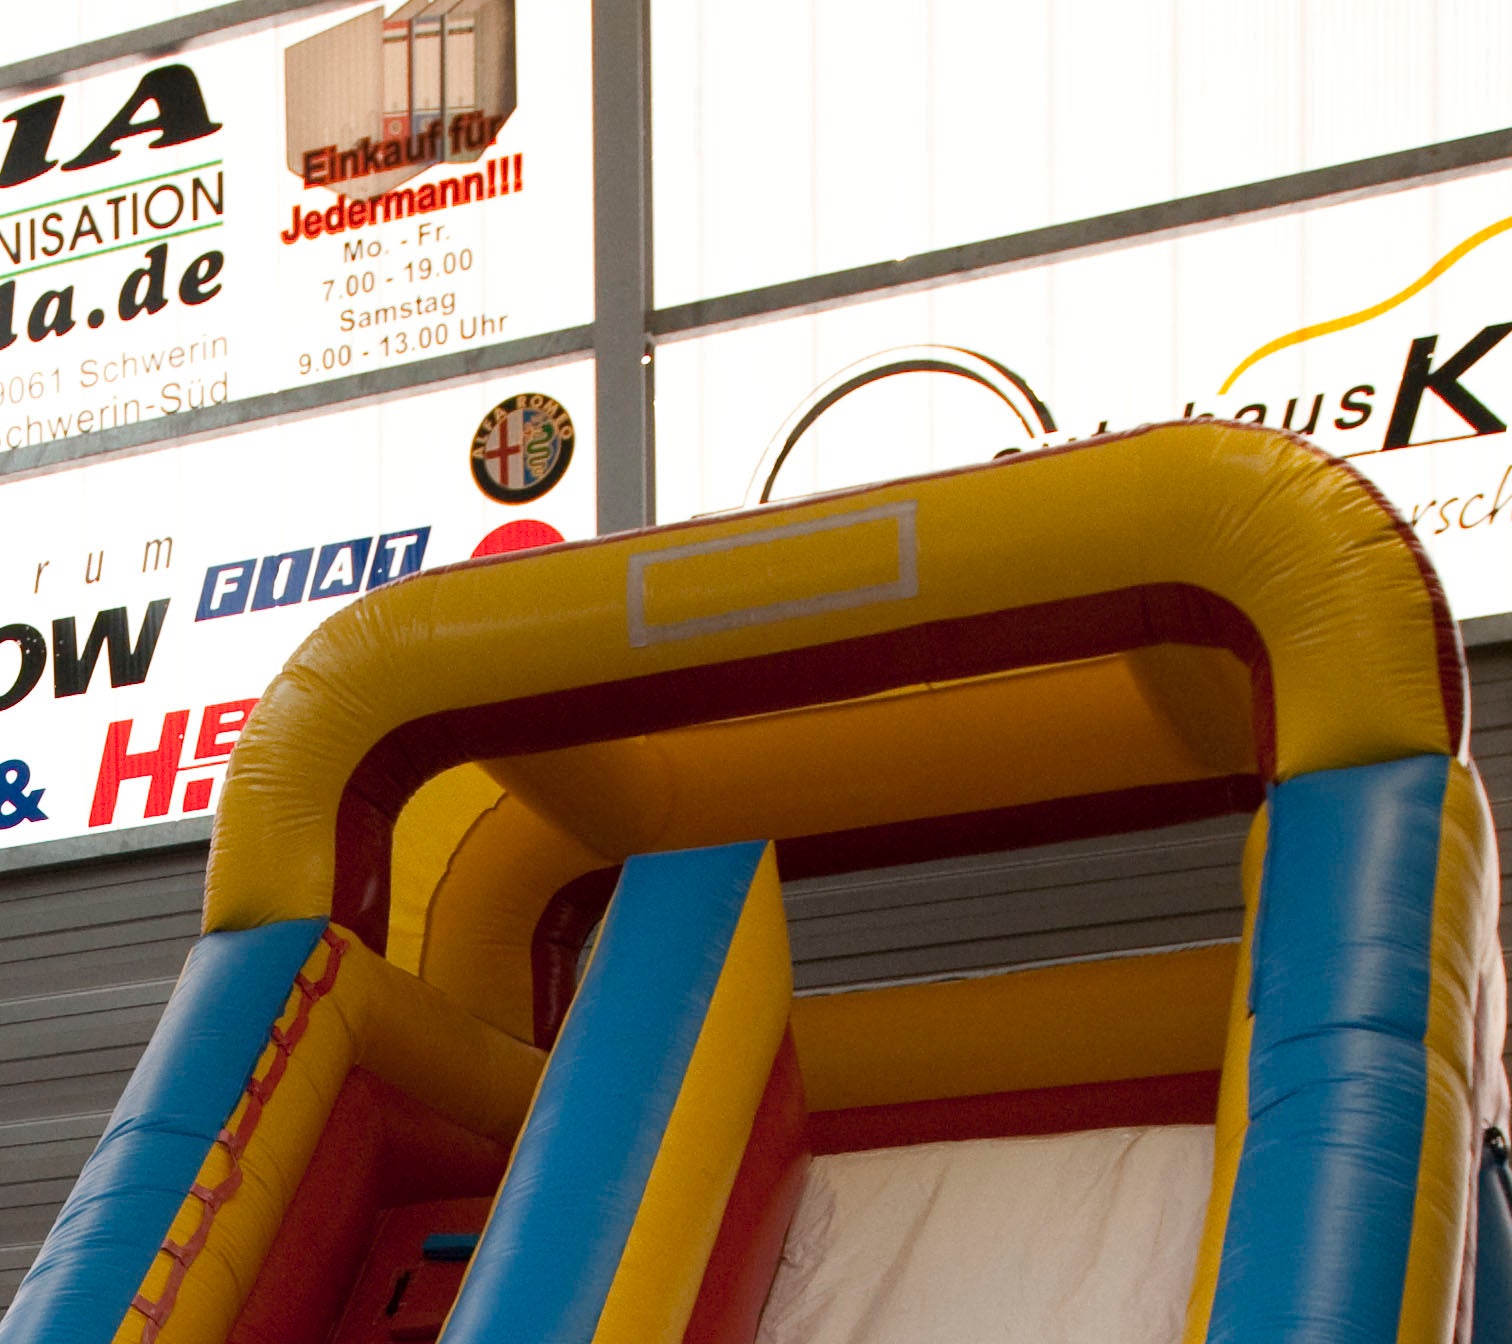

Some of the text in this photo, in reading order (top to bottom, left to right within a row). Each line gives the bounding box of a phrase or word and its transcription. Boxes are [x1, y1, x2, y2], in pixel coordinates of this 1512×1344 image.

[303, 109, 502, 189] Einkauf für
[280, 152, 523, 245] Jedermann!!!
[343, 238, 388, 263] Mo.
[418, 222, 451, 246] Fr.
[322, 270, 375, 301] 7.00
[404, 247, 473, 284] 19.00
[339, 291, 457, 333] Samstag
[79, 332, 228, 388] Schwerin
[298, 344, 352, 375] 9.00
[379, 322, 449, 357] 13.00
[460, 314, 509, 341] Uhr
[208, 533, 421, 617] FIAT
